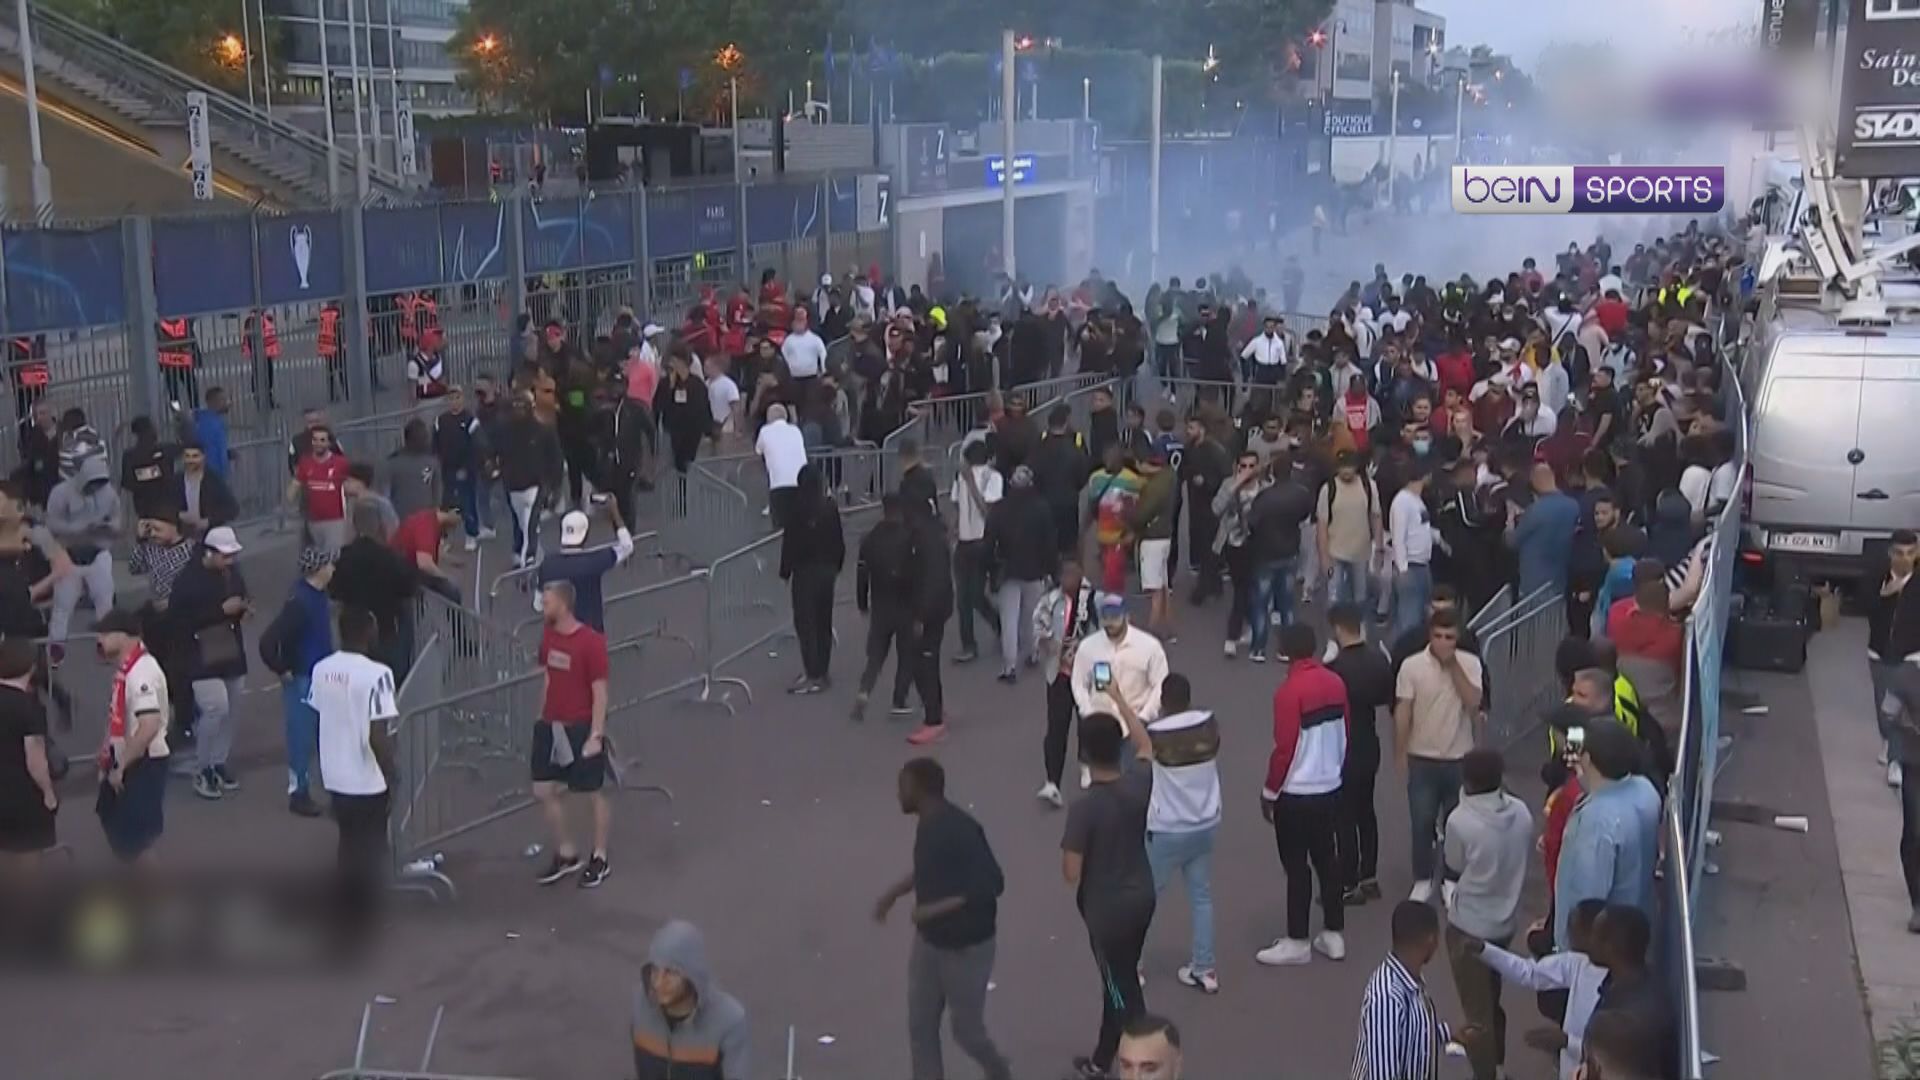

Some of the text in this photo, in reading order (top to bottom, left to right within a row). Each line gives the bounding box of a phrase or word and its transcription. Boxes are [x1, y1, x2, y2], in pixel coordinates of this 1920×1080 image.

[1860, 48, 1920, 69] Sain
[1854, 112, 1920, 139] STAD
[879, 190, 889, 225] Z
